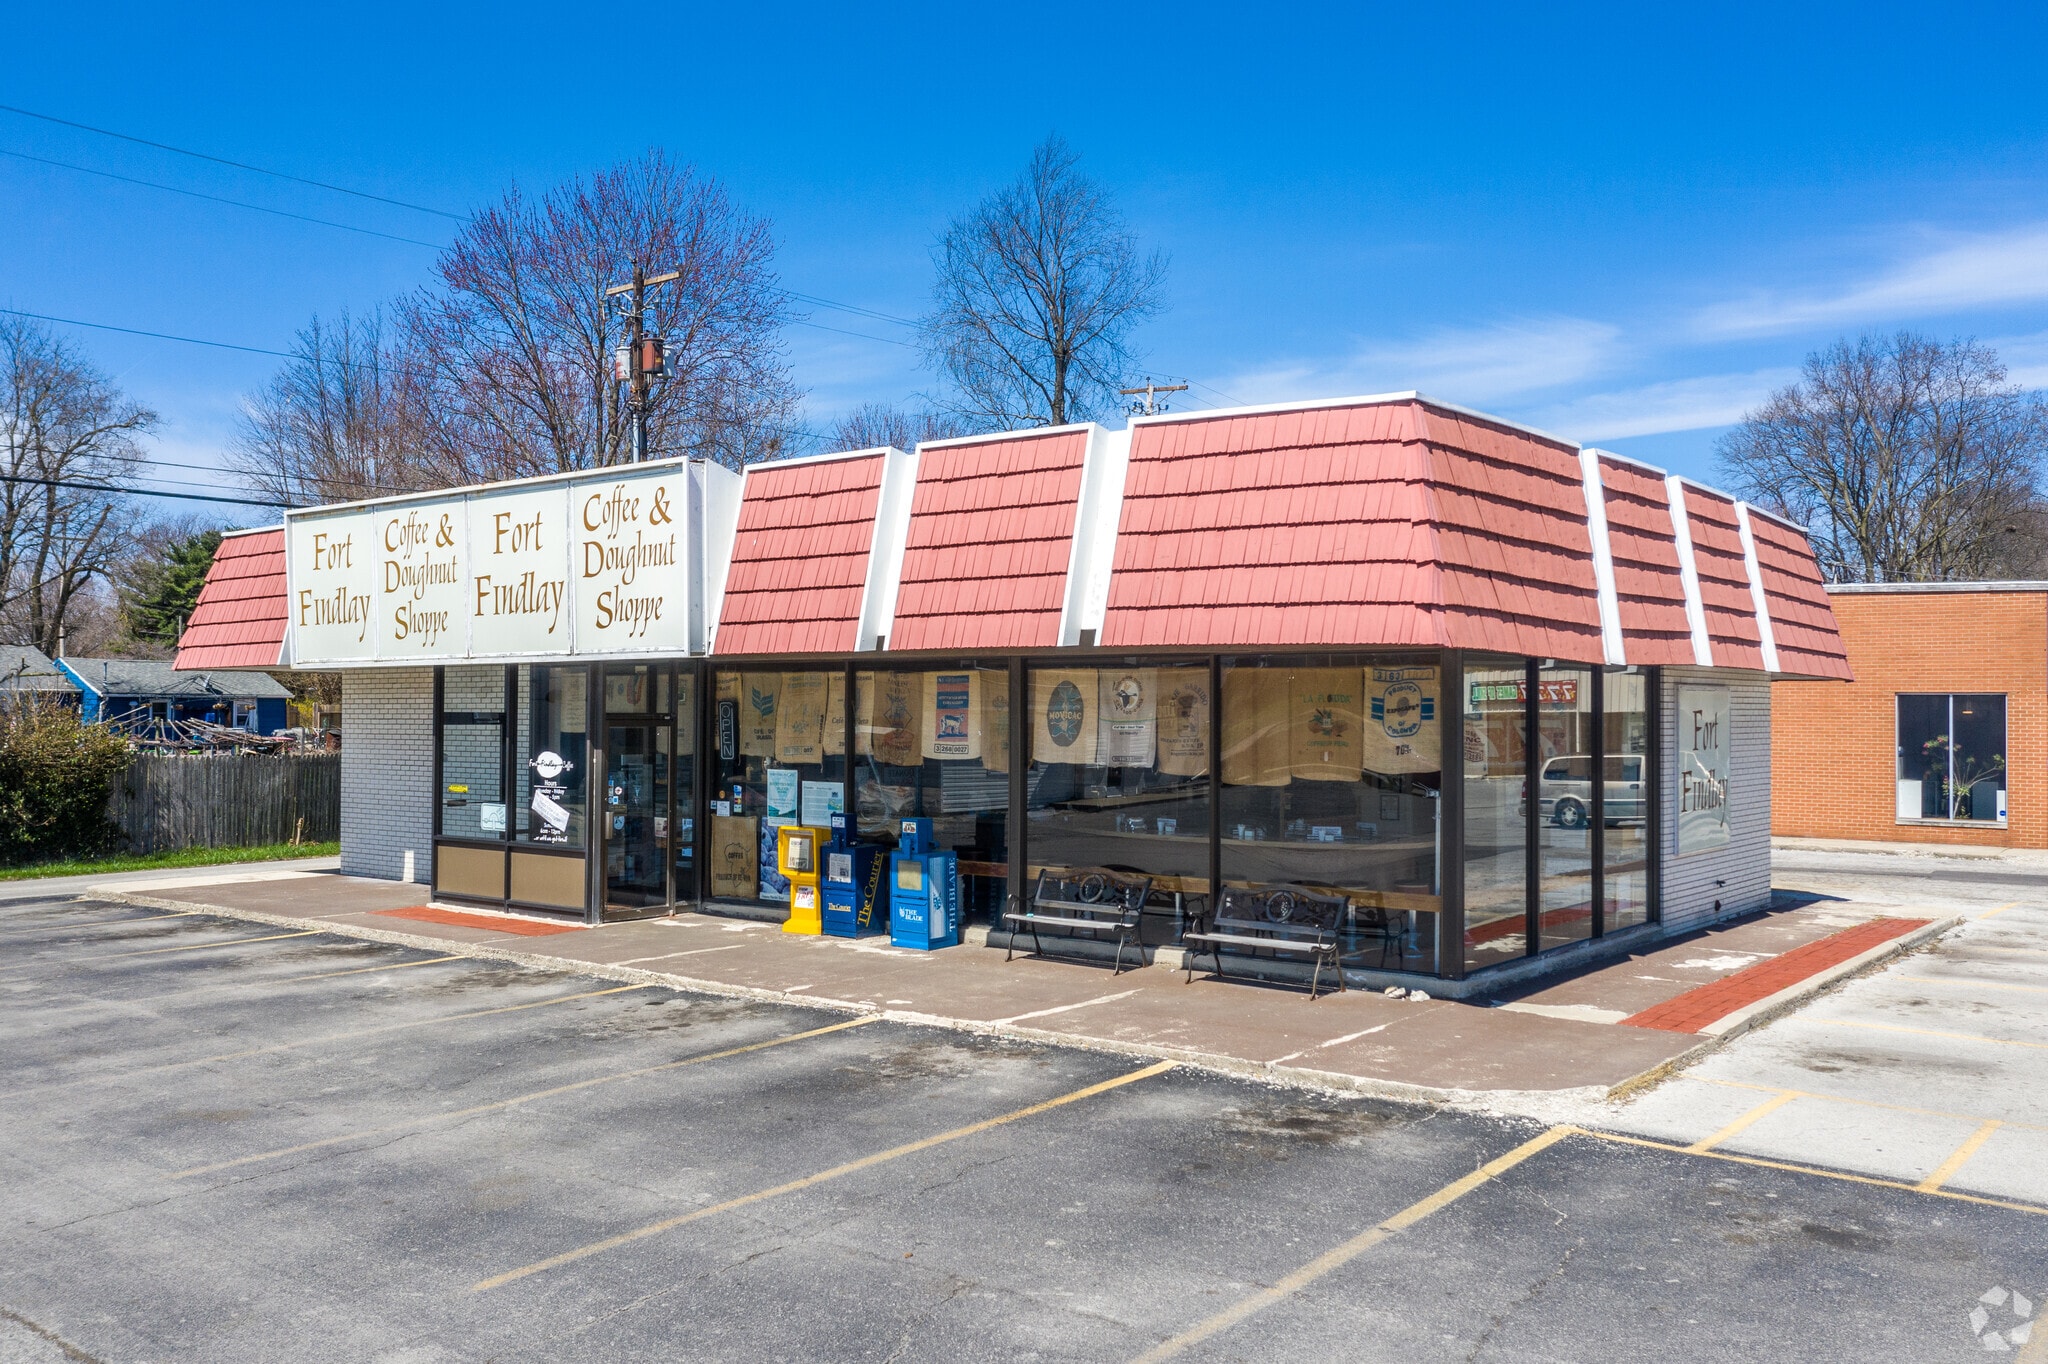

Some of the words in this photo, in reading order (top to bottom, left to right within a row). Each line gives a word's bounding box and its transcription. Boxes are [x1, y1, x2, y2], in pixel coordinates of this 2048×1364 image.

[385, 511, 429, 559] Coffee
[436, 513, 455, 548] &
[493, 511, 543, 554] Fort
[583, 484, 640, 539] Coffee
[649, 486, 672, 526] &
[313, 533, 353, 571] Fort
[384, 551, 458, 600] Doughnut
[582, 530, 676, 585] Doughnut
[298, 586, 371, 642] Findlay
[394, 600, 448, 647] Shoppe
[474, 571, 564, 634] Findlay
[595, 584, 663, 638] Shoppe
[721, 705, 732, 756] OPEN
[1692, 709, 1719, 751] Fort
[1681, 768, 1728, 828] Findlay
[856, 900, 872, 925] The
[864, 851, 883, 899] Courier
[948, 857, 956, 902] BLADE
[904, 914, 924, 922] BLADE
[948, 904, 956, 933] THE
